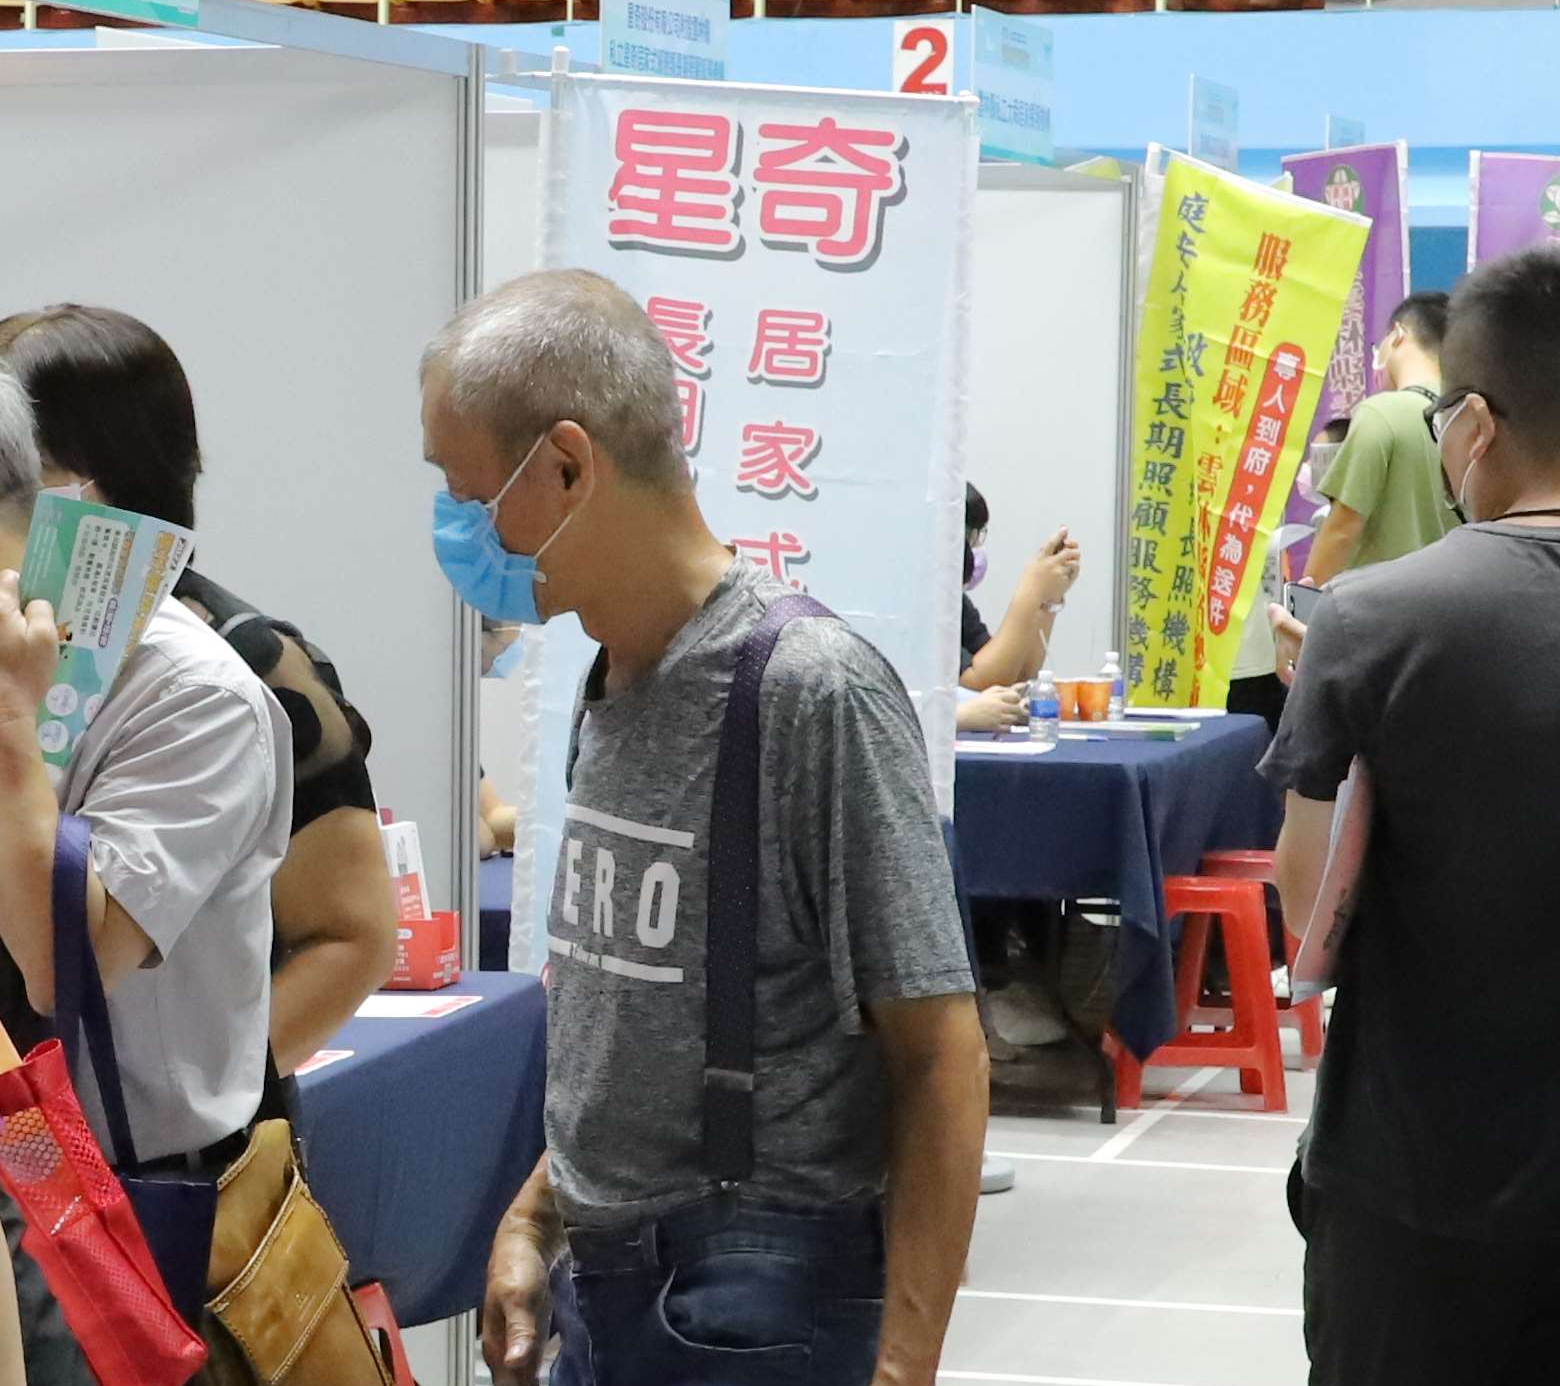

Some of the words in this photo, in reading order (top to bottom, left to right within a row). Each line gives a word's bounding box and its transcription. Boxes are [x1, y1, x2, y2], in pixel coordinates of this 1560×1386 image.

[901, 27, 948, 95] 2
[608, 107, 896, 263] 星奇
[1210, 352, 1301, 626] 專人到府，代為送件
